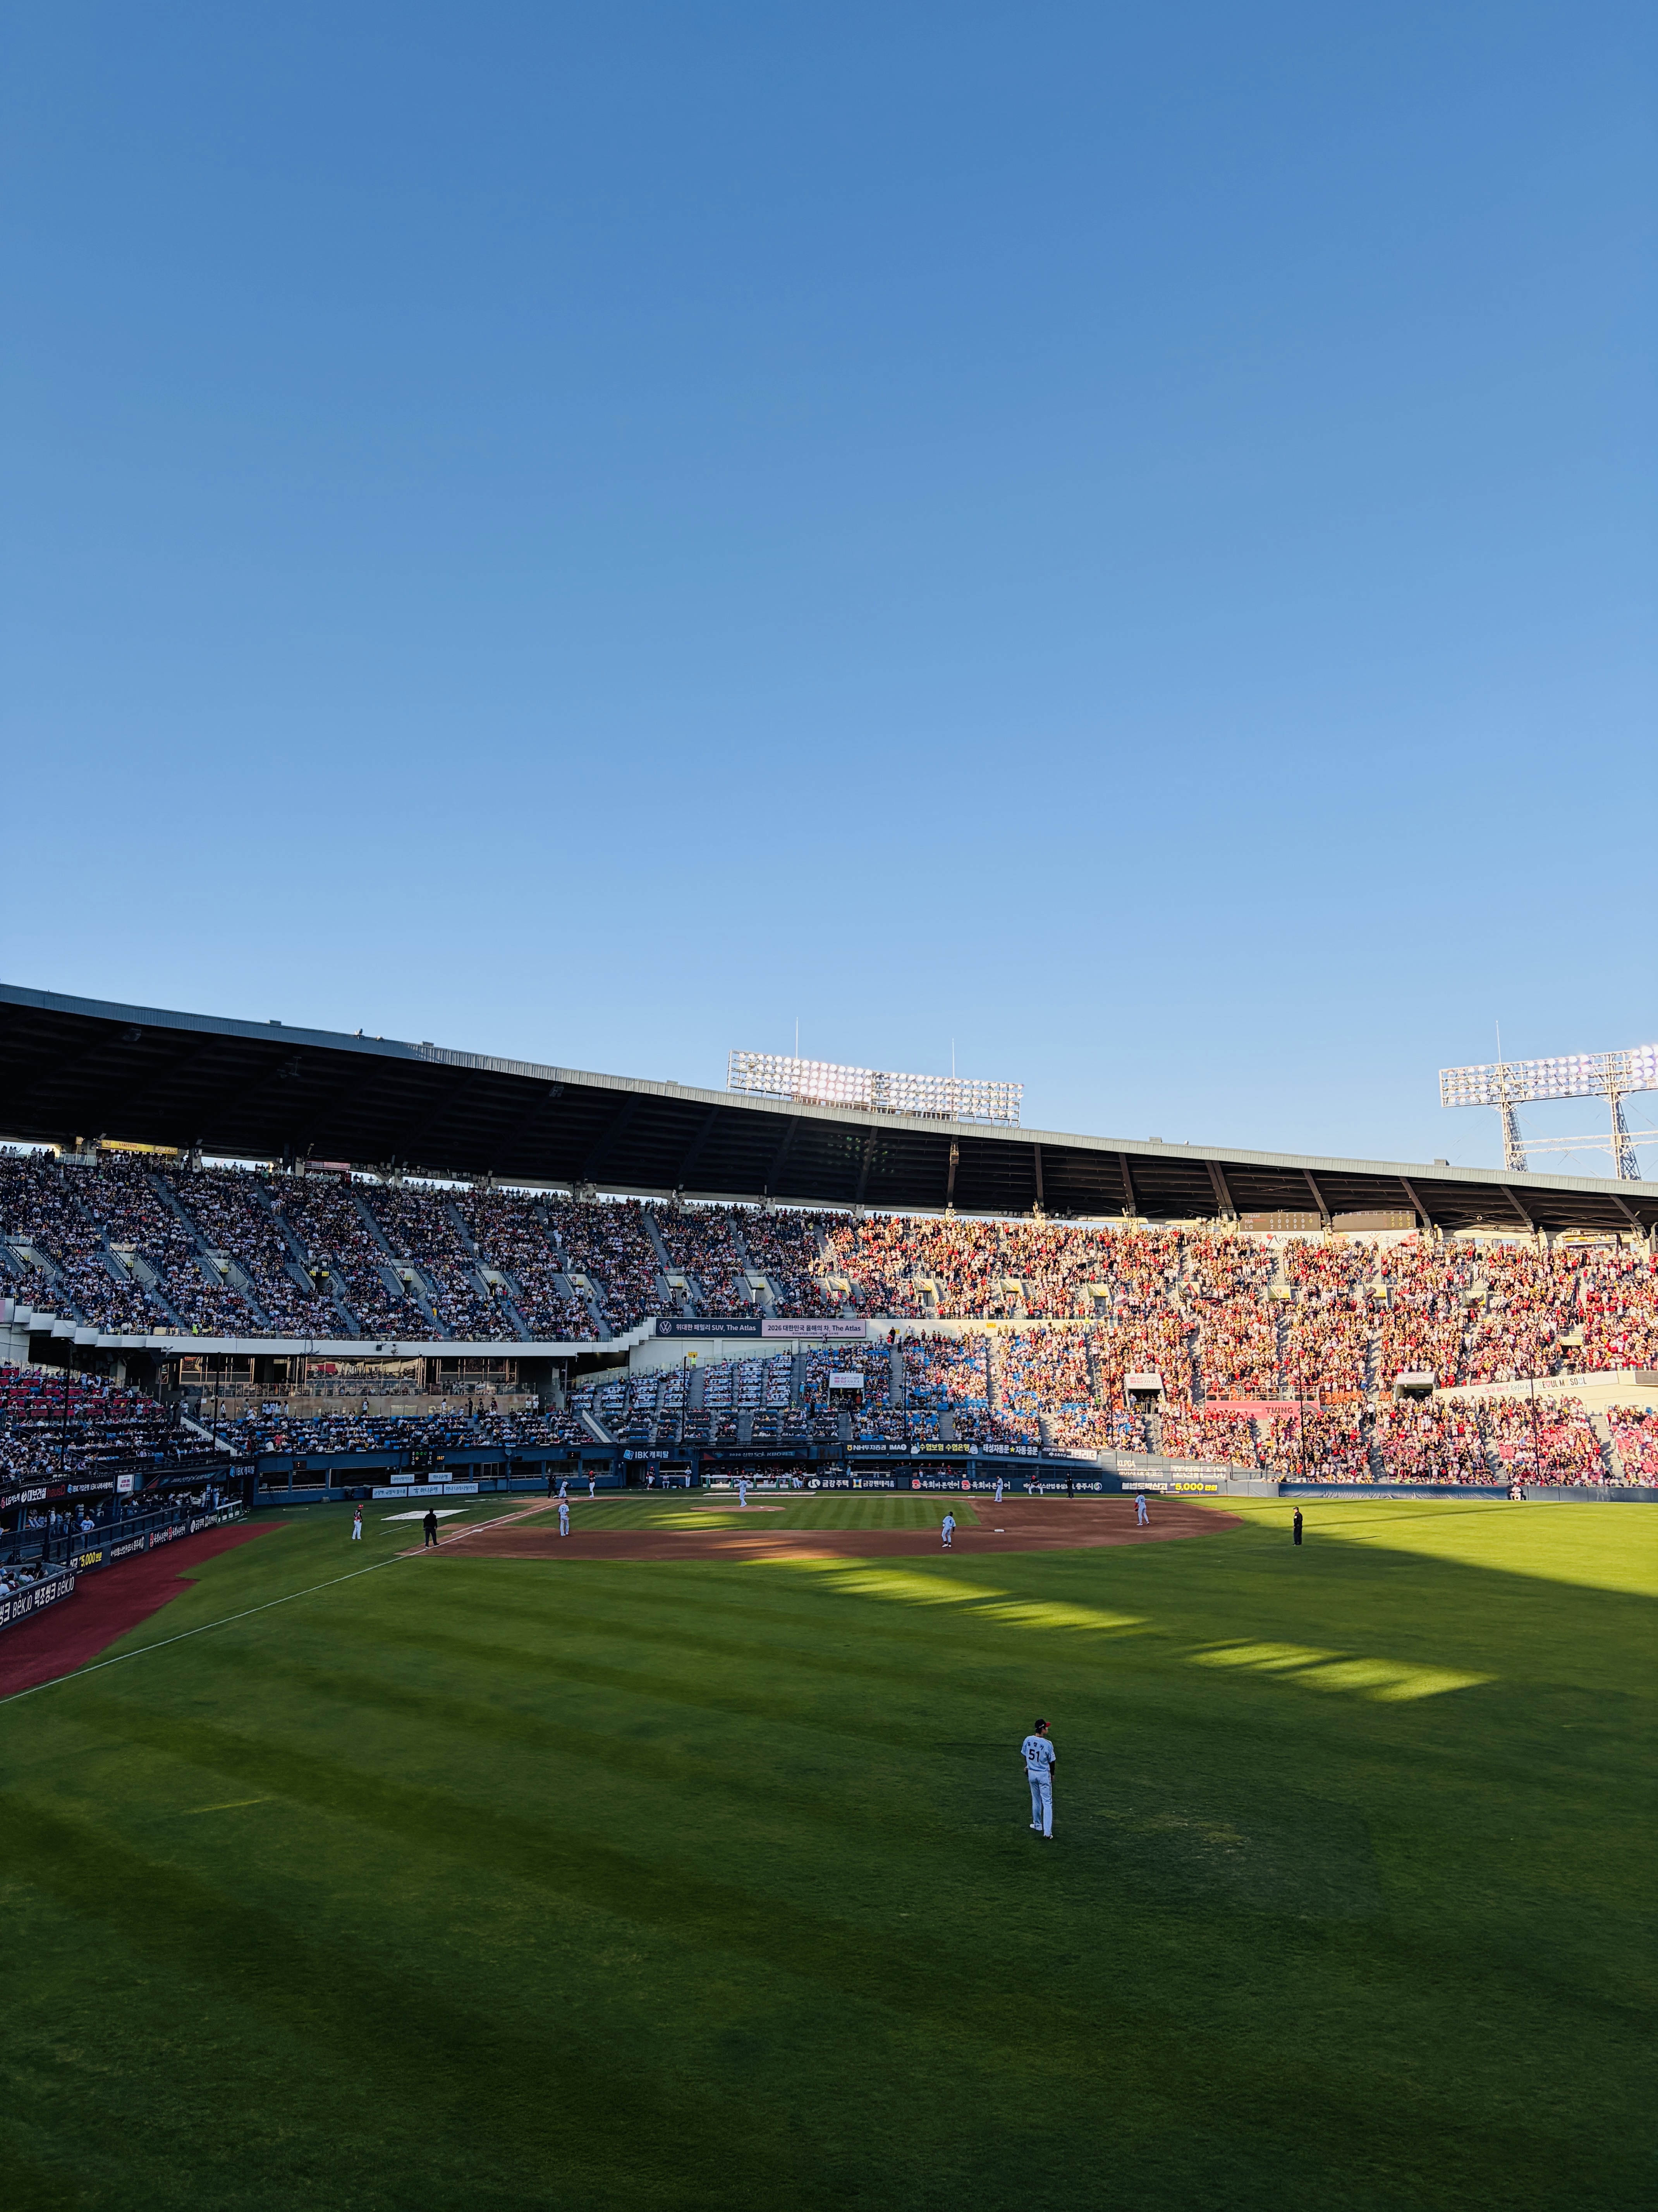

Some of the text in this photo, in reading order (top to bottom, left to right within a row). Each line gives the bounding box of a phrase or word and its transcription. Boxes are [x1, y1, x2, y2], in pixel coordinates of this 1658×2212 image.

[983, 1444, 1009, 1454] 태성자동문
[1015, 1446, 1038, 1456] 자동중문
[1066, 1448, 1097, 1462] 그린리더
[921, 1480, 960, 1489] 육회바른연어
[971, 1481, 1010, 1490] 육회바른어
[34, 1582, 56, 1607] 백조씽크
[1028, 1748, 1039, 1762] 51
